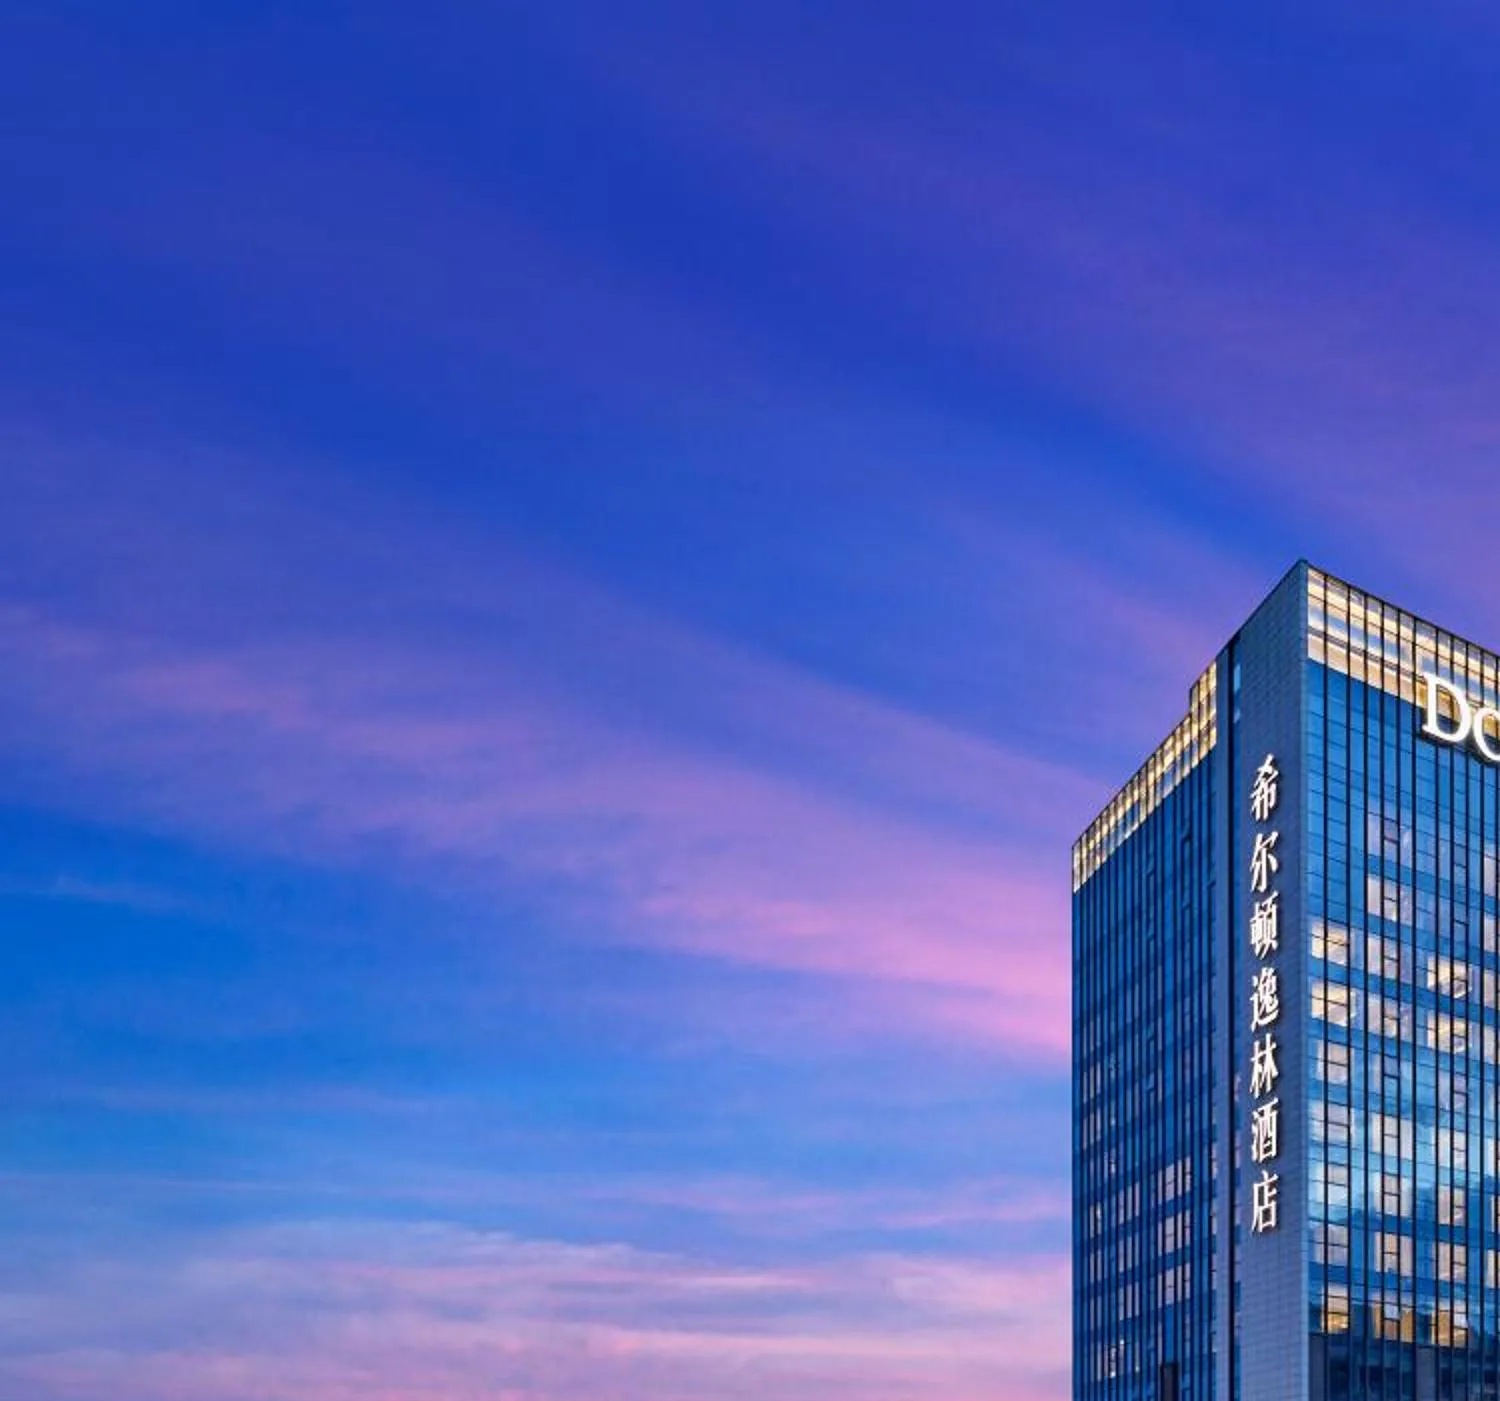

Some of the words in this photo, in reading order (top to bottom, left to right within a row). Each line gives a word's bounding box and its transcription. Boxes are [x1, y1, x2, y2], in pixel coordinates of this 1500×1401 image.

[1249, 754, 1279, 1234] 希尔顿逸林酒店
